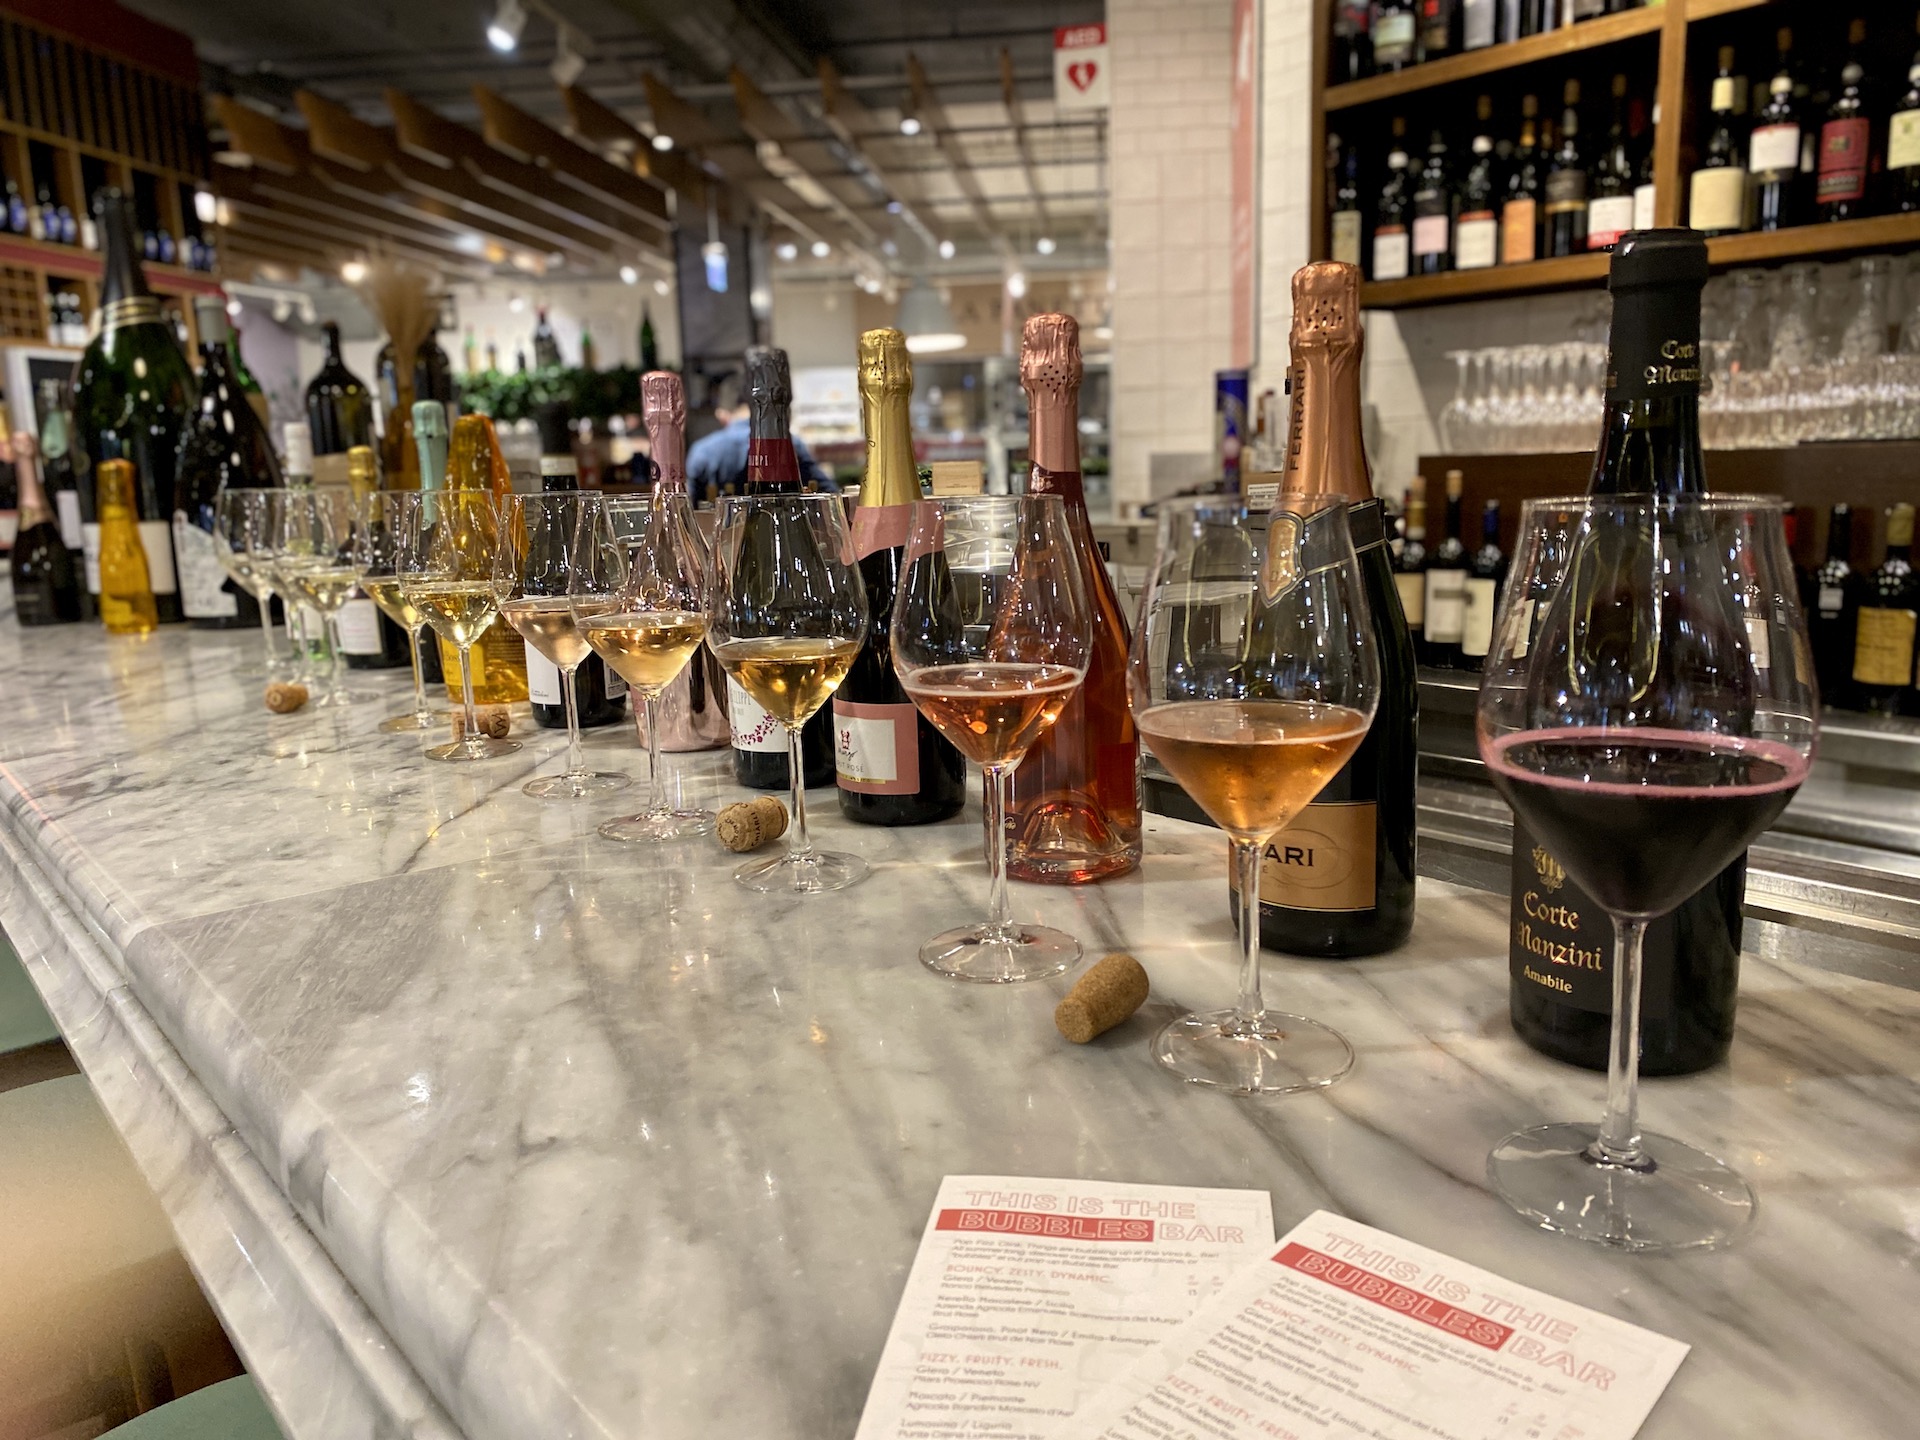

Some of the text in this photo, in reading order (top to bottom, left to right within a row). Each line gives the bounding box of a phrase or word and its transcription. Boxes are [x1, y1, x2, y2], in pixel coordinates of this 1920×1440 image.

[1289, 369, 1304, 471] FERRARI
[1523, 890, 1580, 930] Corte
[1517, 920, 1604, 971] Manzini
[1523, 964, 1574, 994] Amabile
[961, 1190, 1199, 1219] THIS IS THE
[955, 1209, 1248, 1244] BUBBLES BAR
[1027, 1243, 1058, 1251] Things
[1075, 1246, 1118, 1256] bubbling
[943, 1274, 974, 1282] Glera
[985, 1276, 1023, 1285] Veneto
[1314, 1230, 1582, 1346] THIS IS THE
[1001, 1326, 1028, 1334] Pinot
[1031, 1328, 1058, 1336] Nero
[1150, 1317, 1183, 1325] Murgo
[1291, 1248, 1623, 1392] BUBBLES BAR
[916, 1365, 950, 1375] Glera
[963, 1368, 1005, 1377] Veneto
[909, 1391, 956, 1401] Moscato
[971, 1393, 1025, 1403] Piemonte
